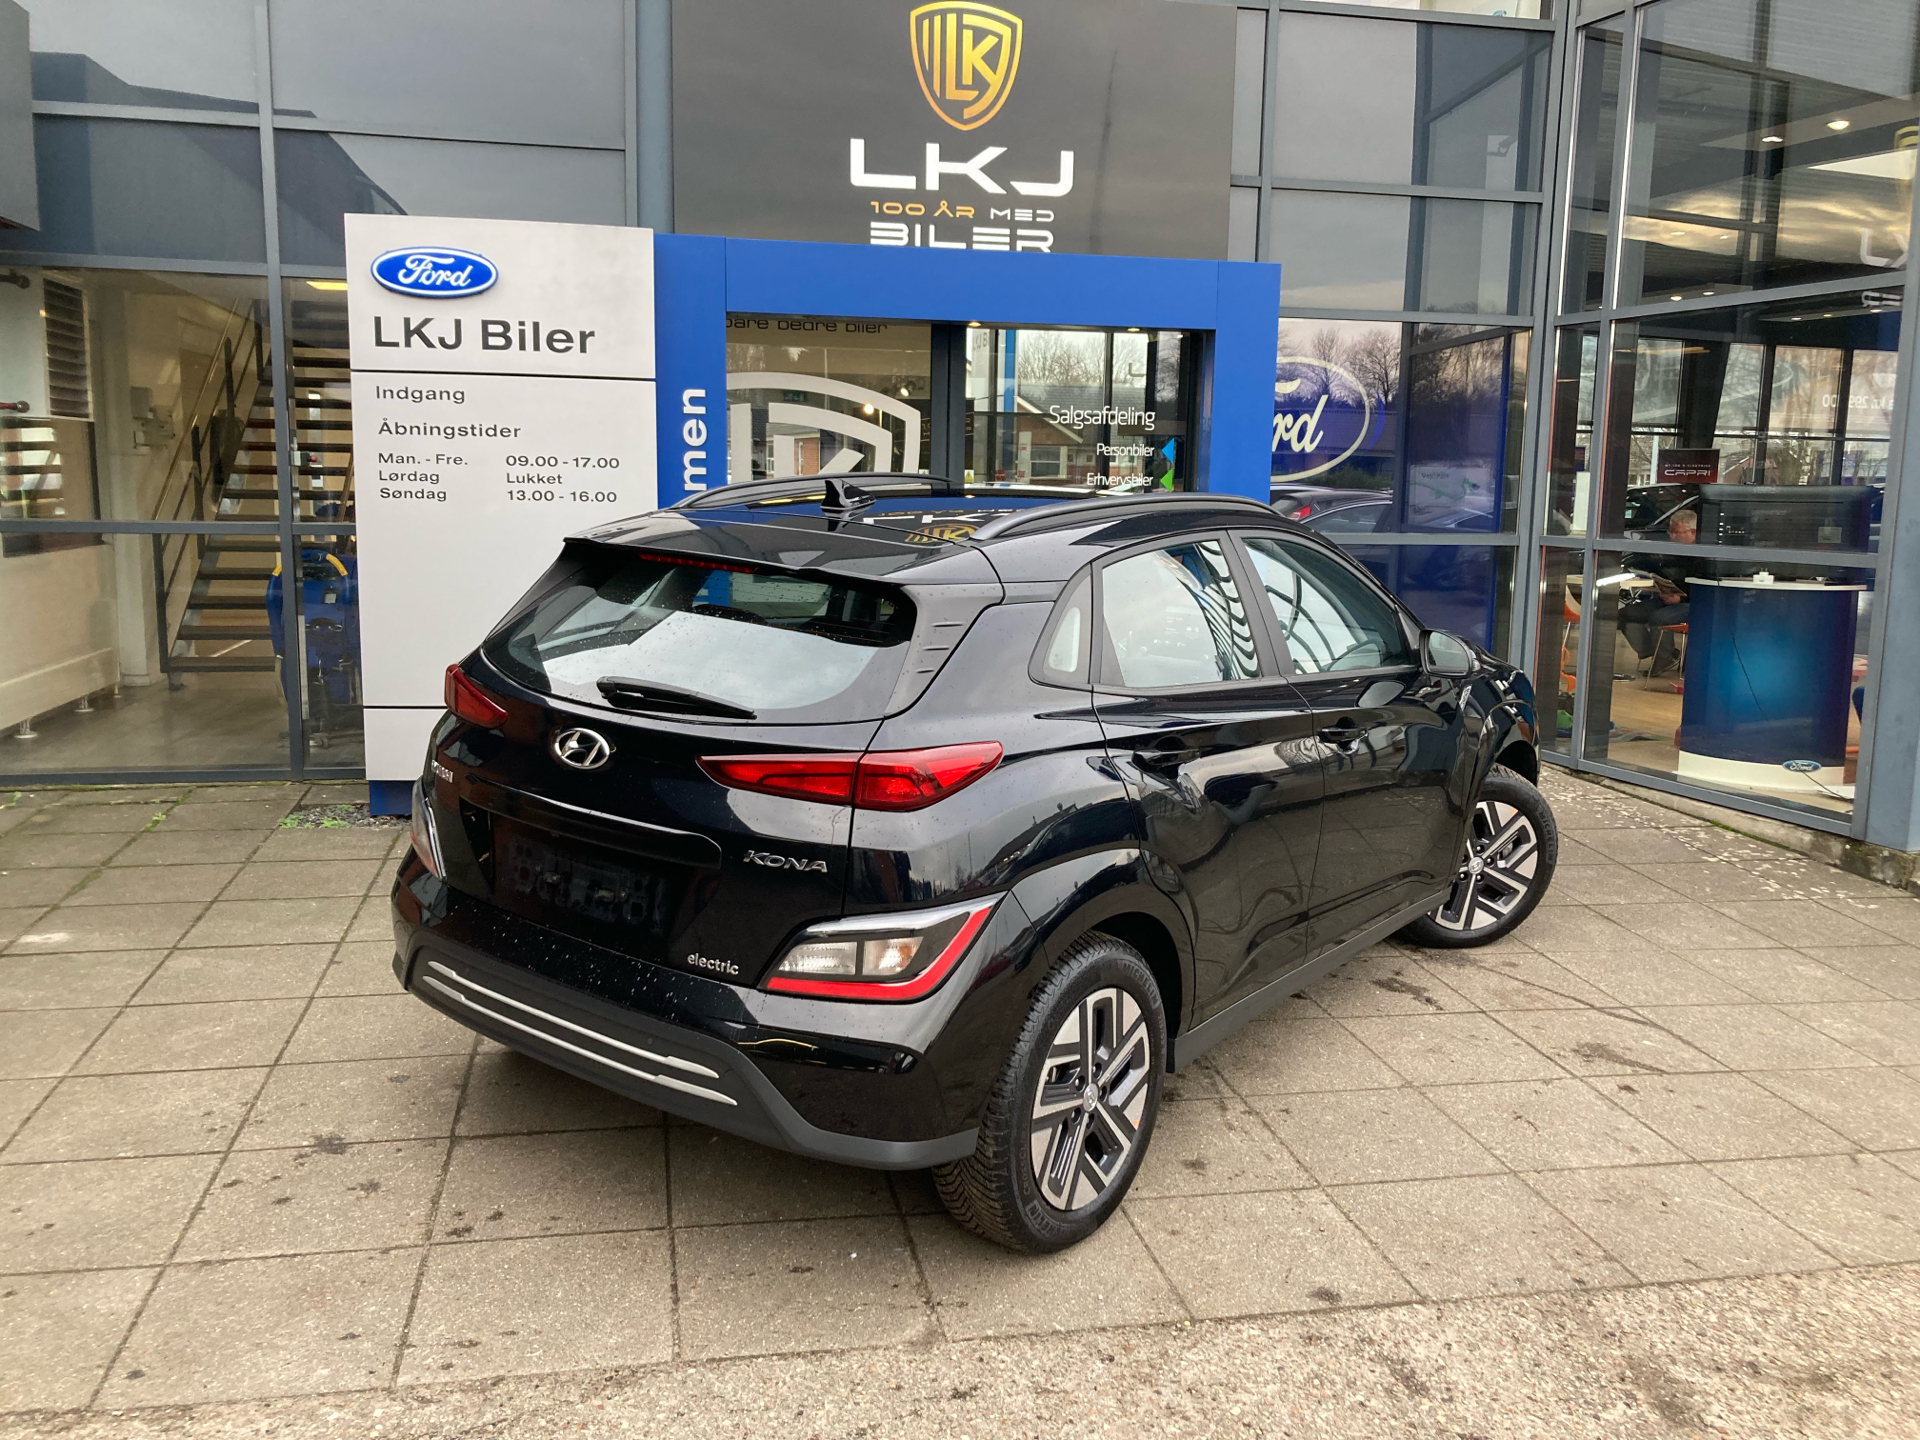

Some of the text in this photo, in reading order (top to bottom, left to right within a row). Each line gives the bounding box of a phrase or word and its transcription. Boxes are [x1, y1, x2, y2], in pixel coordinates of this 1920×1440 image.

[850, 138, 1074, 197] LKJ
[871, 200, 1055, 222] 100 ÅR MED
[870, 221, 1053, 252] BILER
[398, 254, 473, 287] Ford
[374, 316, 595, 353] LKJ Biler
[376, 385, 465, 404] Indgang
[378, 417, 522, 440] Åbningstider
[1049, 404, 1156, 431] Salgsafdeling
[682, 388, 707, 491] men
[1096, 443, 1155, 457] Personbiler
[378, 453, 421, 465] Man.
[435, 454, 469, 466] Fre.
[505, 455, 559, 467] 09.00
[572, 457, 620, 469] 17.00
[379, 470, 563, 485] Lørdag Lukket
[1086, 472, 1154, 486] Erhvervsbiler
[380, 488, 447, 502] Søndag
[507, 490, 555, 502] 13.00
[570, 491, 617, 503] 16.00
[743, 849, 828, 873] KONA
[687, 952, 739, 975] electric
